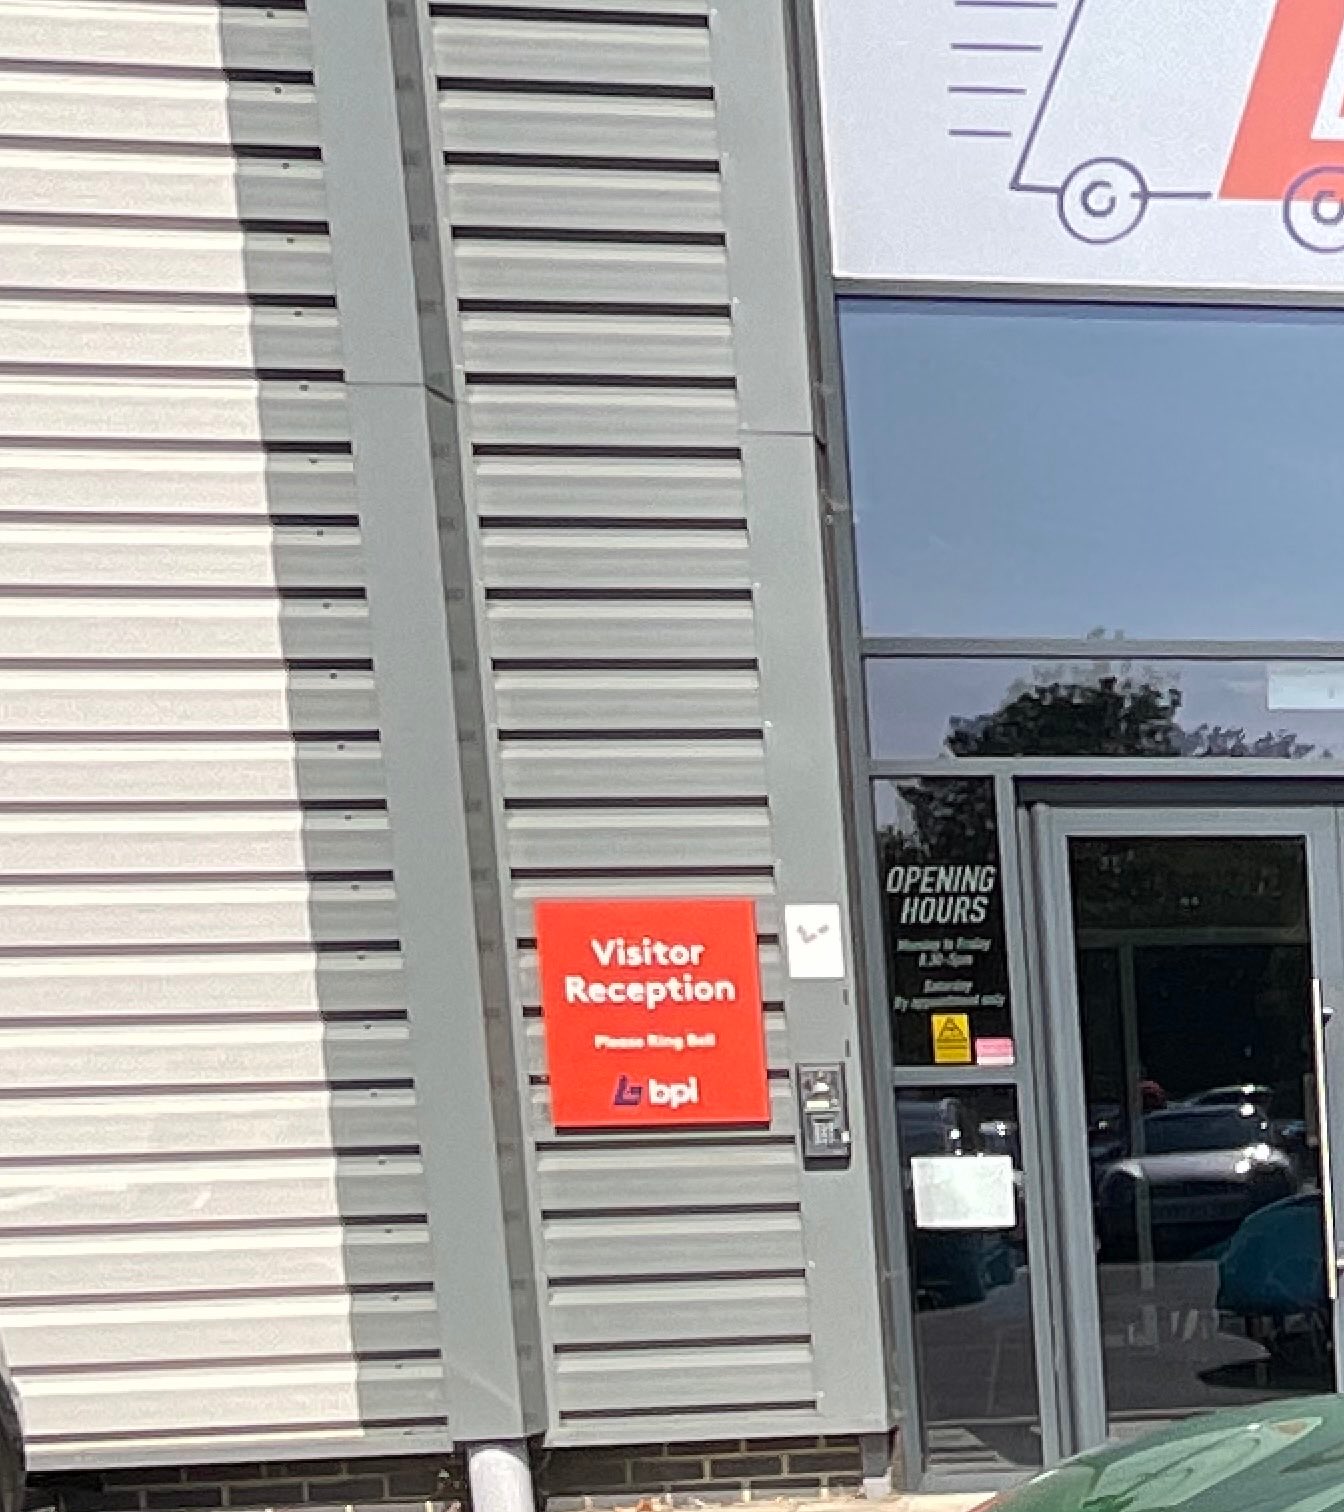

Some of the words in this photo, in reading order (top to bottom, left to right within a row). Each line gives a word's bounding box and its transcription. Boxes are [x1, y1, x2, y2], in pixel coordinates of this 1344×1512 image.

[886, 864, 997, 894] OPENING
[900, 895, 989, 925] HOURS
[590, 936, 705, 967] Visitor
[564, 973, 736, 1010] Reception
